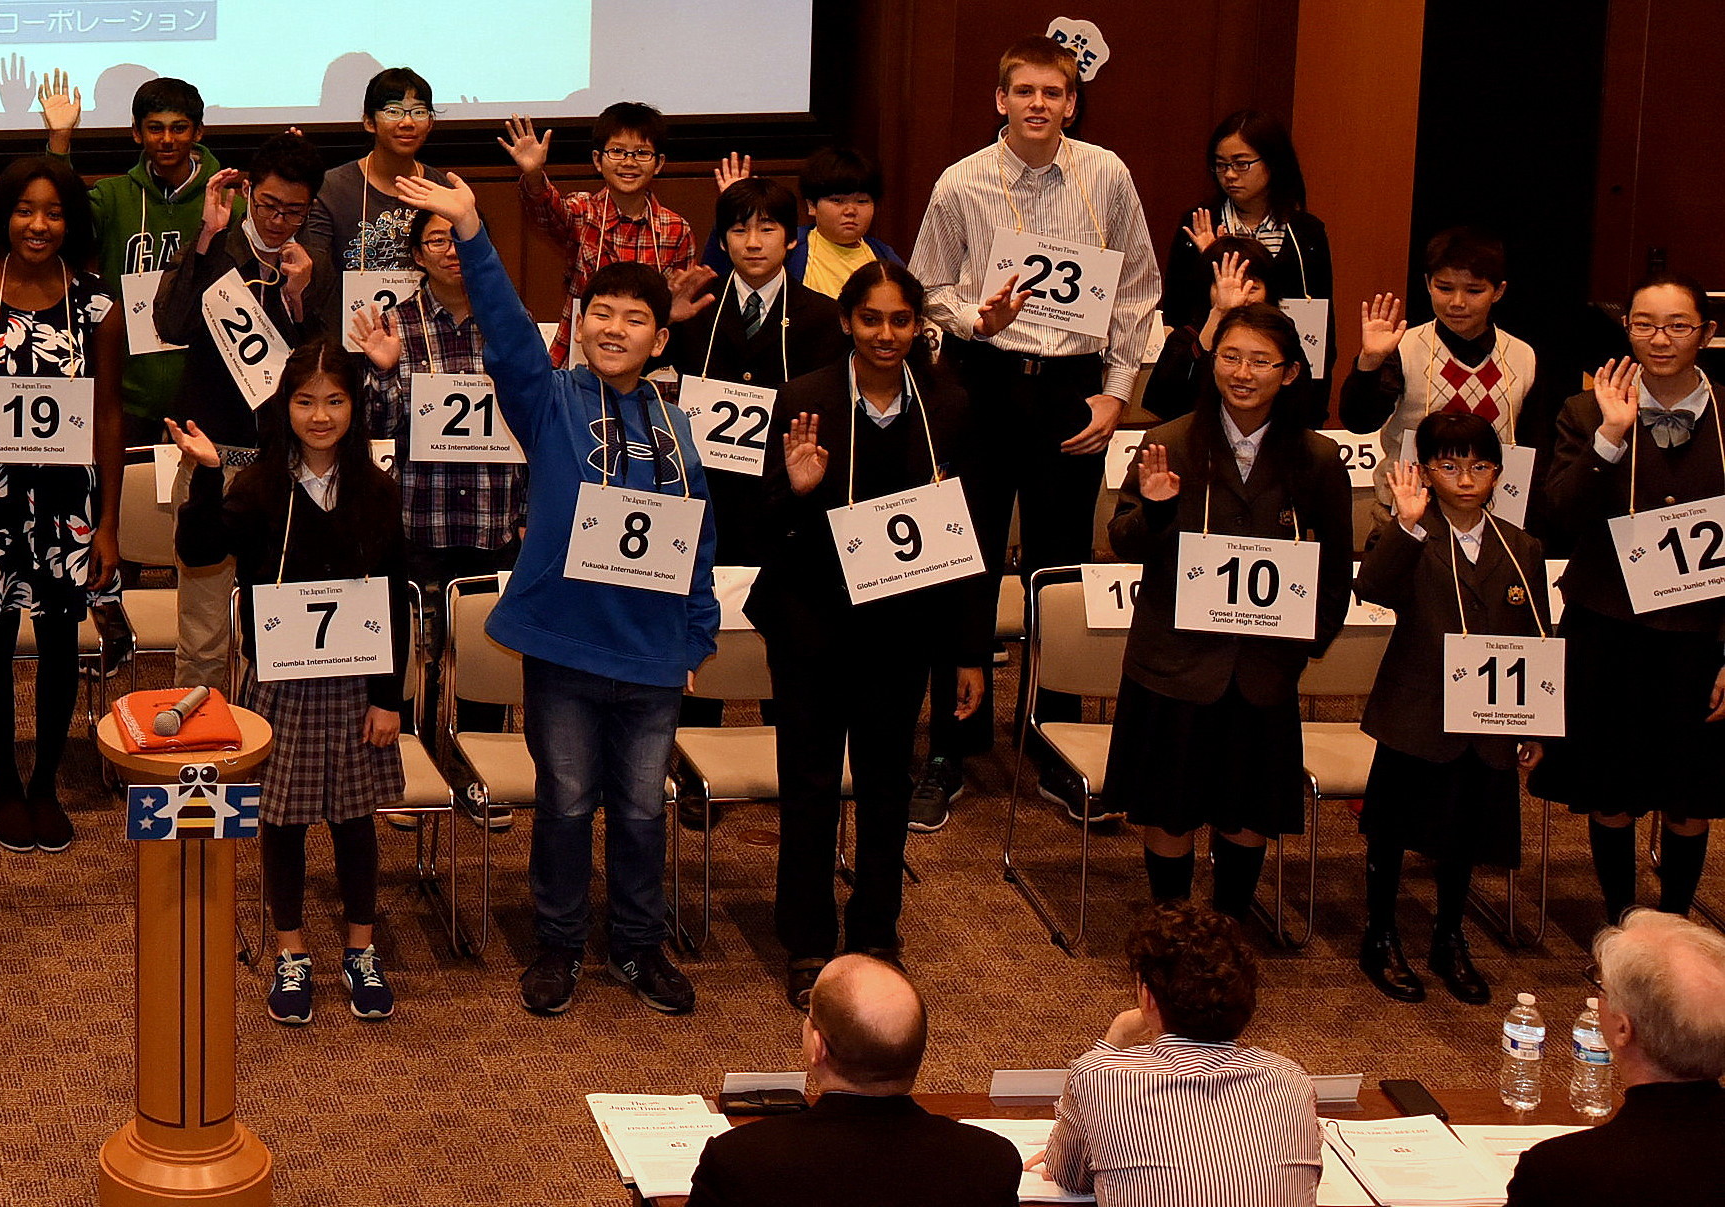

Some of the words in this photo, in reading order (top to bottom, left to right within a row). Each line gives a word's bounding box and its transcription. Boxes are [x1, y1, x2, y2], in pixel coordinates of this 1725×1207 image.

[1016, 254, 1082, 304] 23
[1041, 305, 1085, 319] International
[1048, 313, 1071, 322] School
[220, 307, 269, 366] 20
[3, 395, 60, 439] 19
[441, 392, 494, 437] 21
[705, 400, 770, 450] 22
[448, 444, 489, 452] International
[710, 450, 728, 459] Kaiyo
[729, 453, 758, 464] Academy
[1339, 443, 1377, 470] 25
[874, 504, 885, 512] The
[884, 501, 901, 511] Japan
[900, 497, 917, 505] Times
[619, 511, 652, 560] 8
[886, 513, 923, 562] 9
[1657, 520, 1725, 575] 12
[581, 560, 609, 570] Fukuoka
[610, 565, 653, 577] International
[654, 571, 676, 580] School
[856, 580, 879, 590] Global
[880, 574, 903, 585] Indian
[904, 561, 949, 577] International
[949, 555, 974, 566] School
[1216, 556, 1280, 608] 10
[1653, 587, 1682, 597] Gyoshu
[1683, 581, 1706, 590] Junior
[306, 601, 338, 650] 7
[1209, 609, 1233, 618] Gyosei
[1234, 611, 1282, 621] International
[1211, 616, 1234, 624] Junior
[1235, 617, 1253, 626] High
[1254, 619, 1279, 627] School
[272, 659, 305, 668] Columbia
[306, 656, 353, 666] International
[353, 655, 377, 663] School
[1477, 656, 1526, 706] 11
[1472, 711, 1493, 719] Gyosei
[1494, 711, 1535, 720] International
[1480, 718, 1504, 726] Primary
[1505, 718, 1527, 726] School
